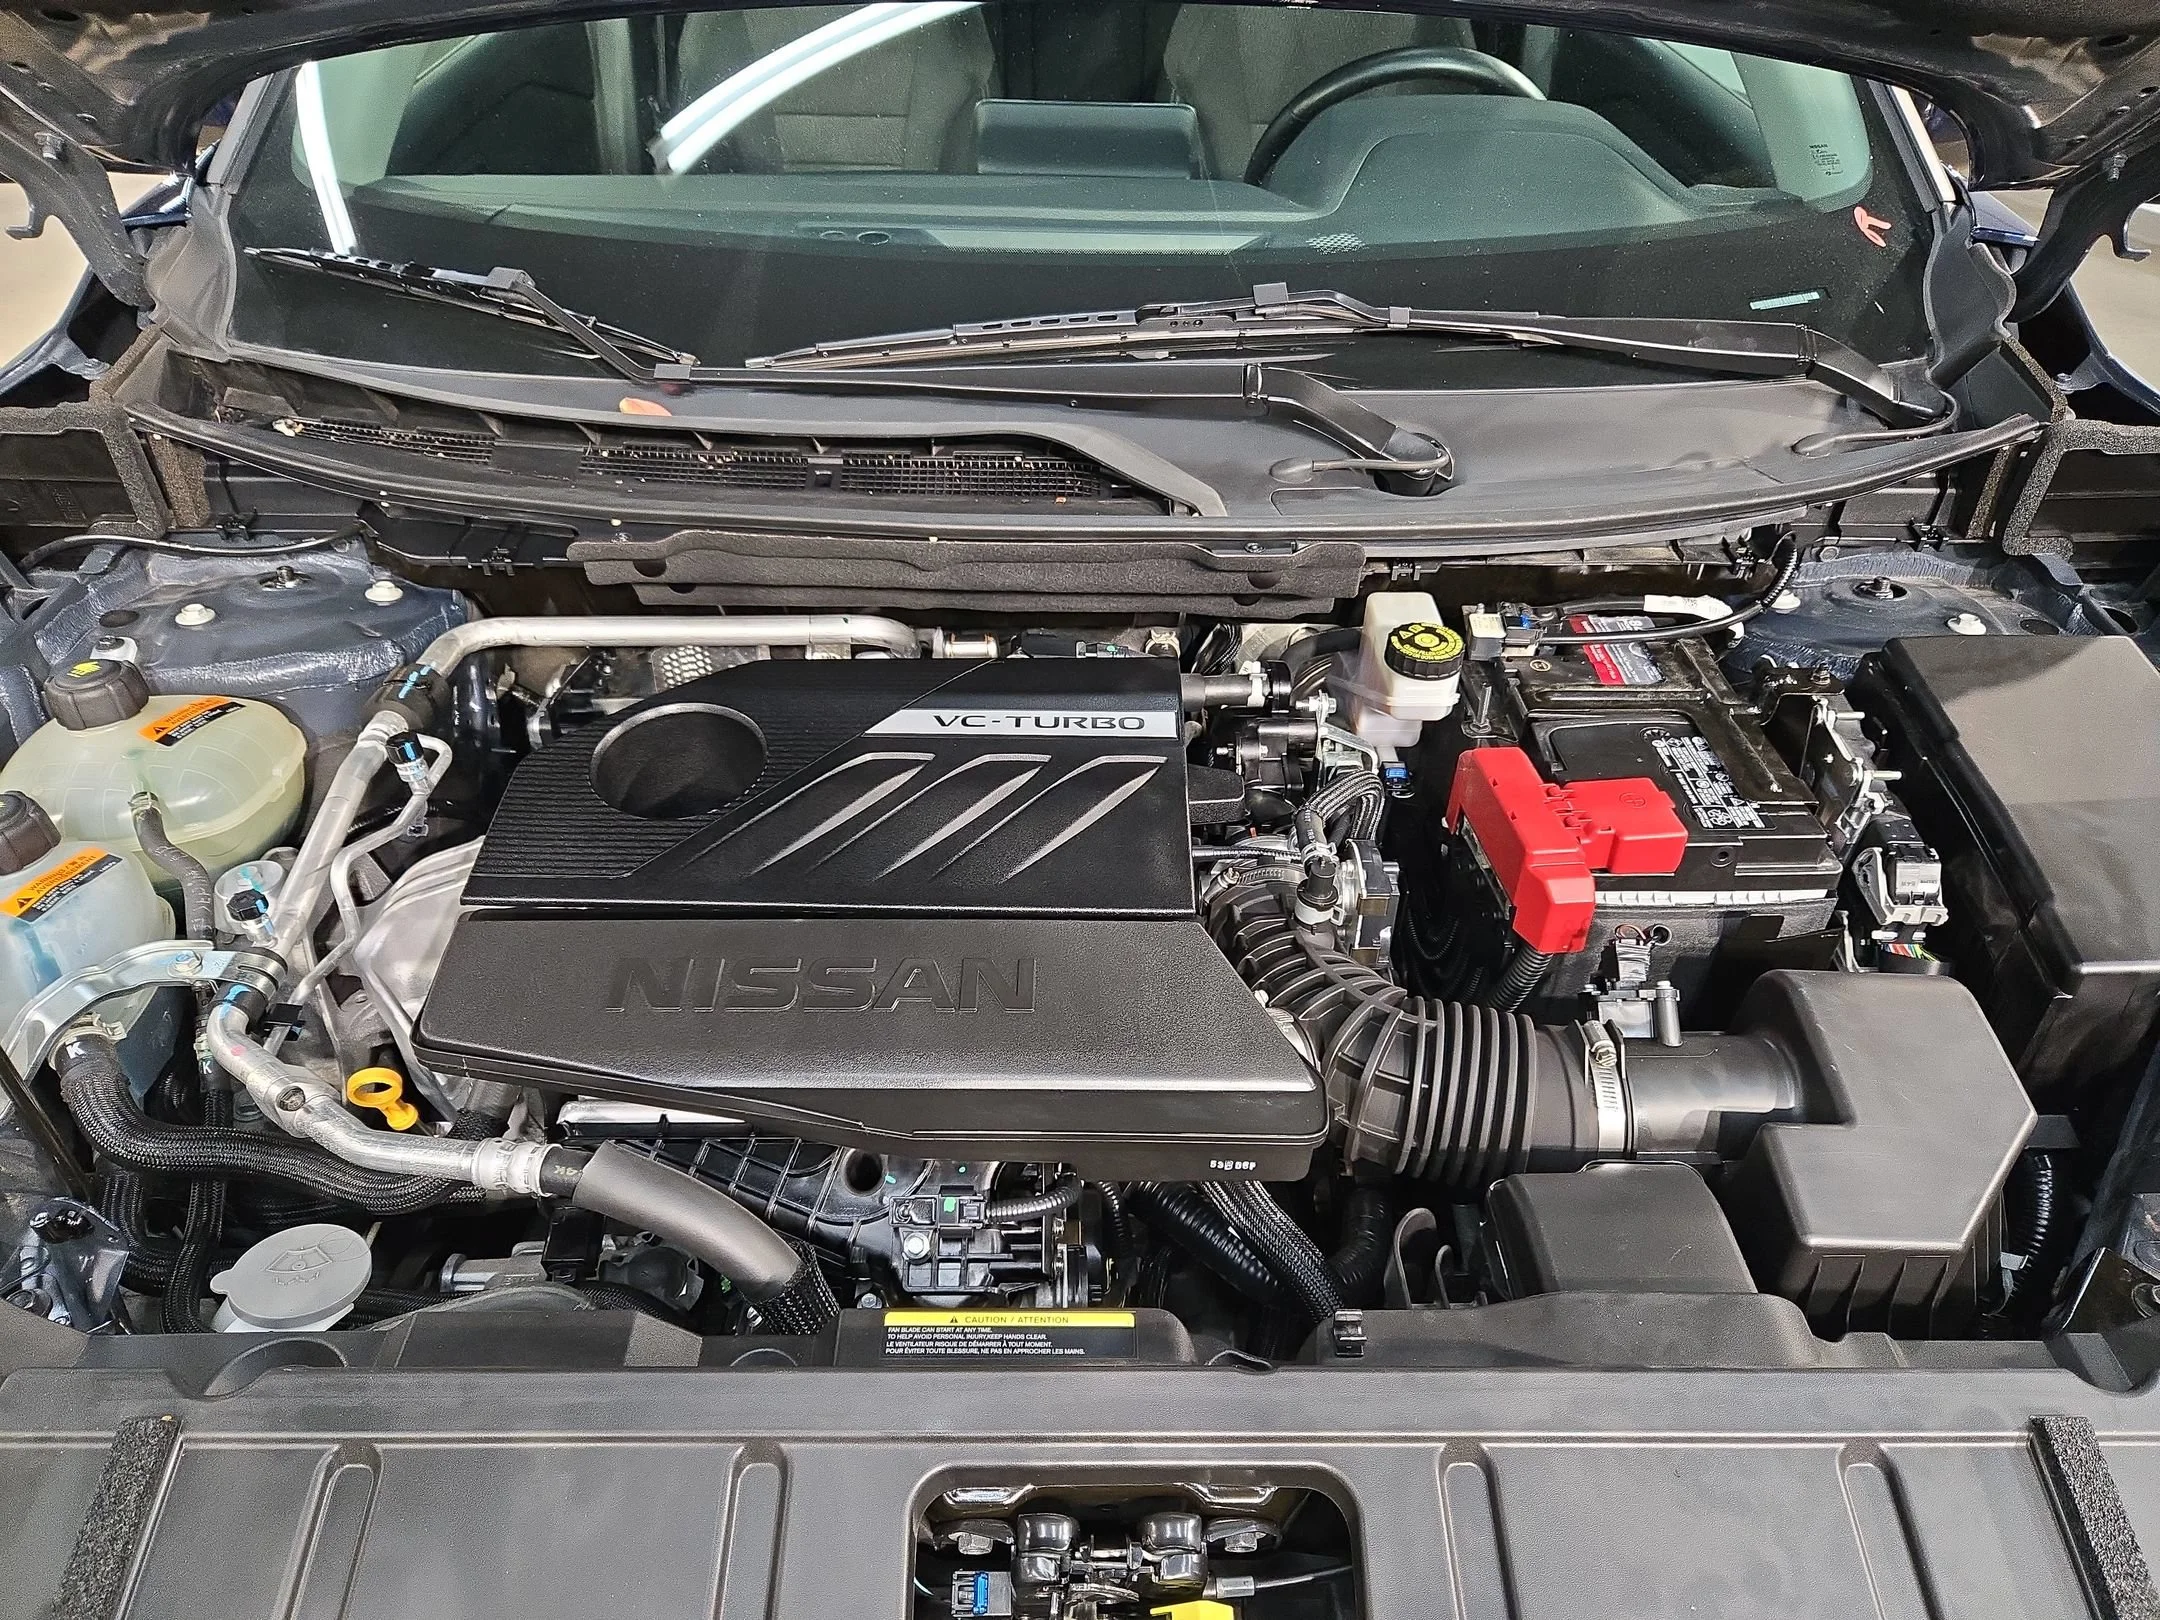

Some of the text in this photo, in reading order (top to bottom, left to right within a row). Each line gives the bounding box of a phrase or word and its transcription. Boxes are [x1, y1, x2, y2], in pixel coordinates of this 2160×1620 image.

[933, 715, 1145, 730] VC-TURBO
[604, 957, 1037, 1013] NISSAN
[65, 1041, 86, 1060] K
[202, 1061, 213, 1075] K
